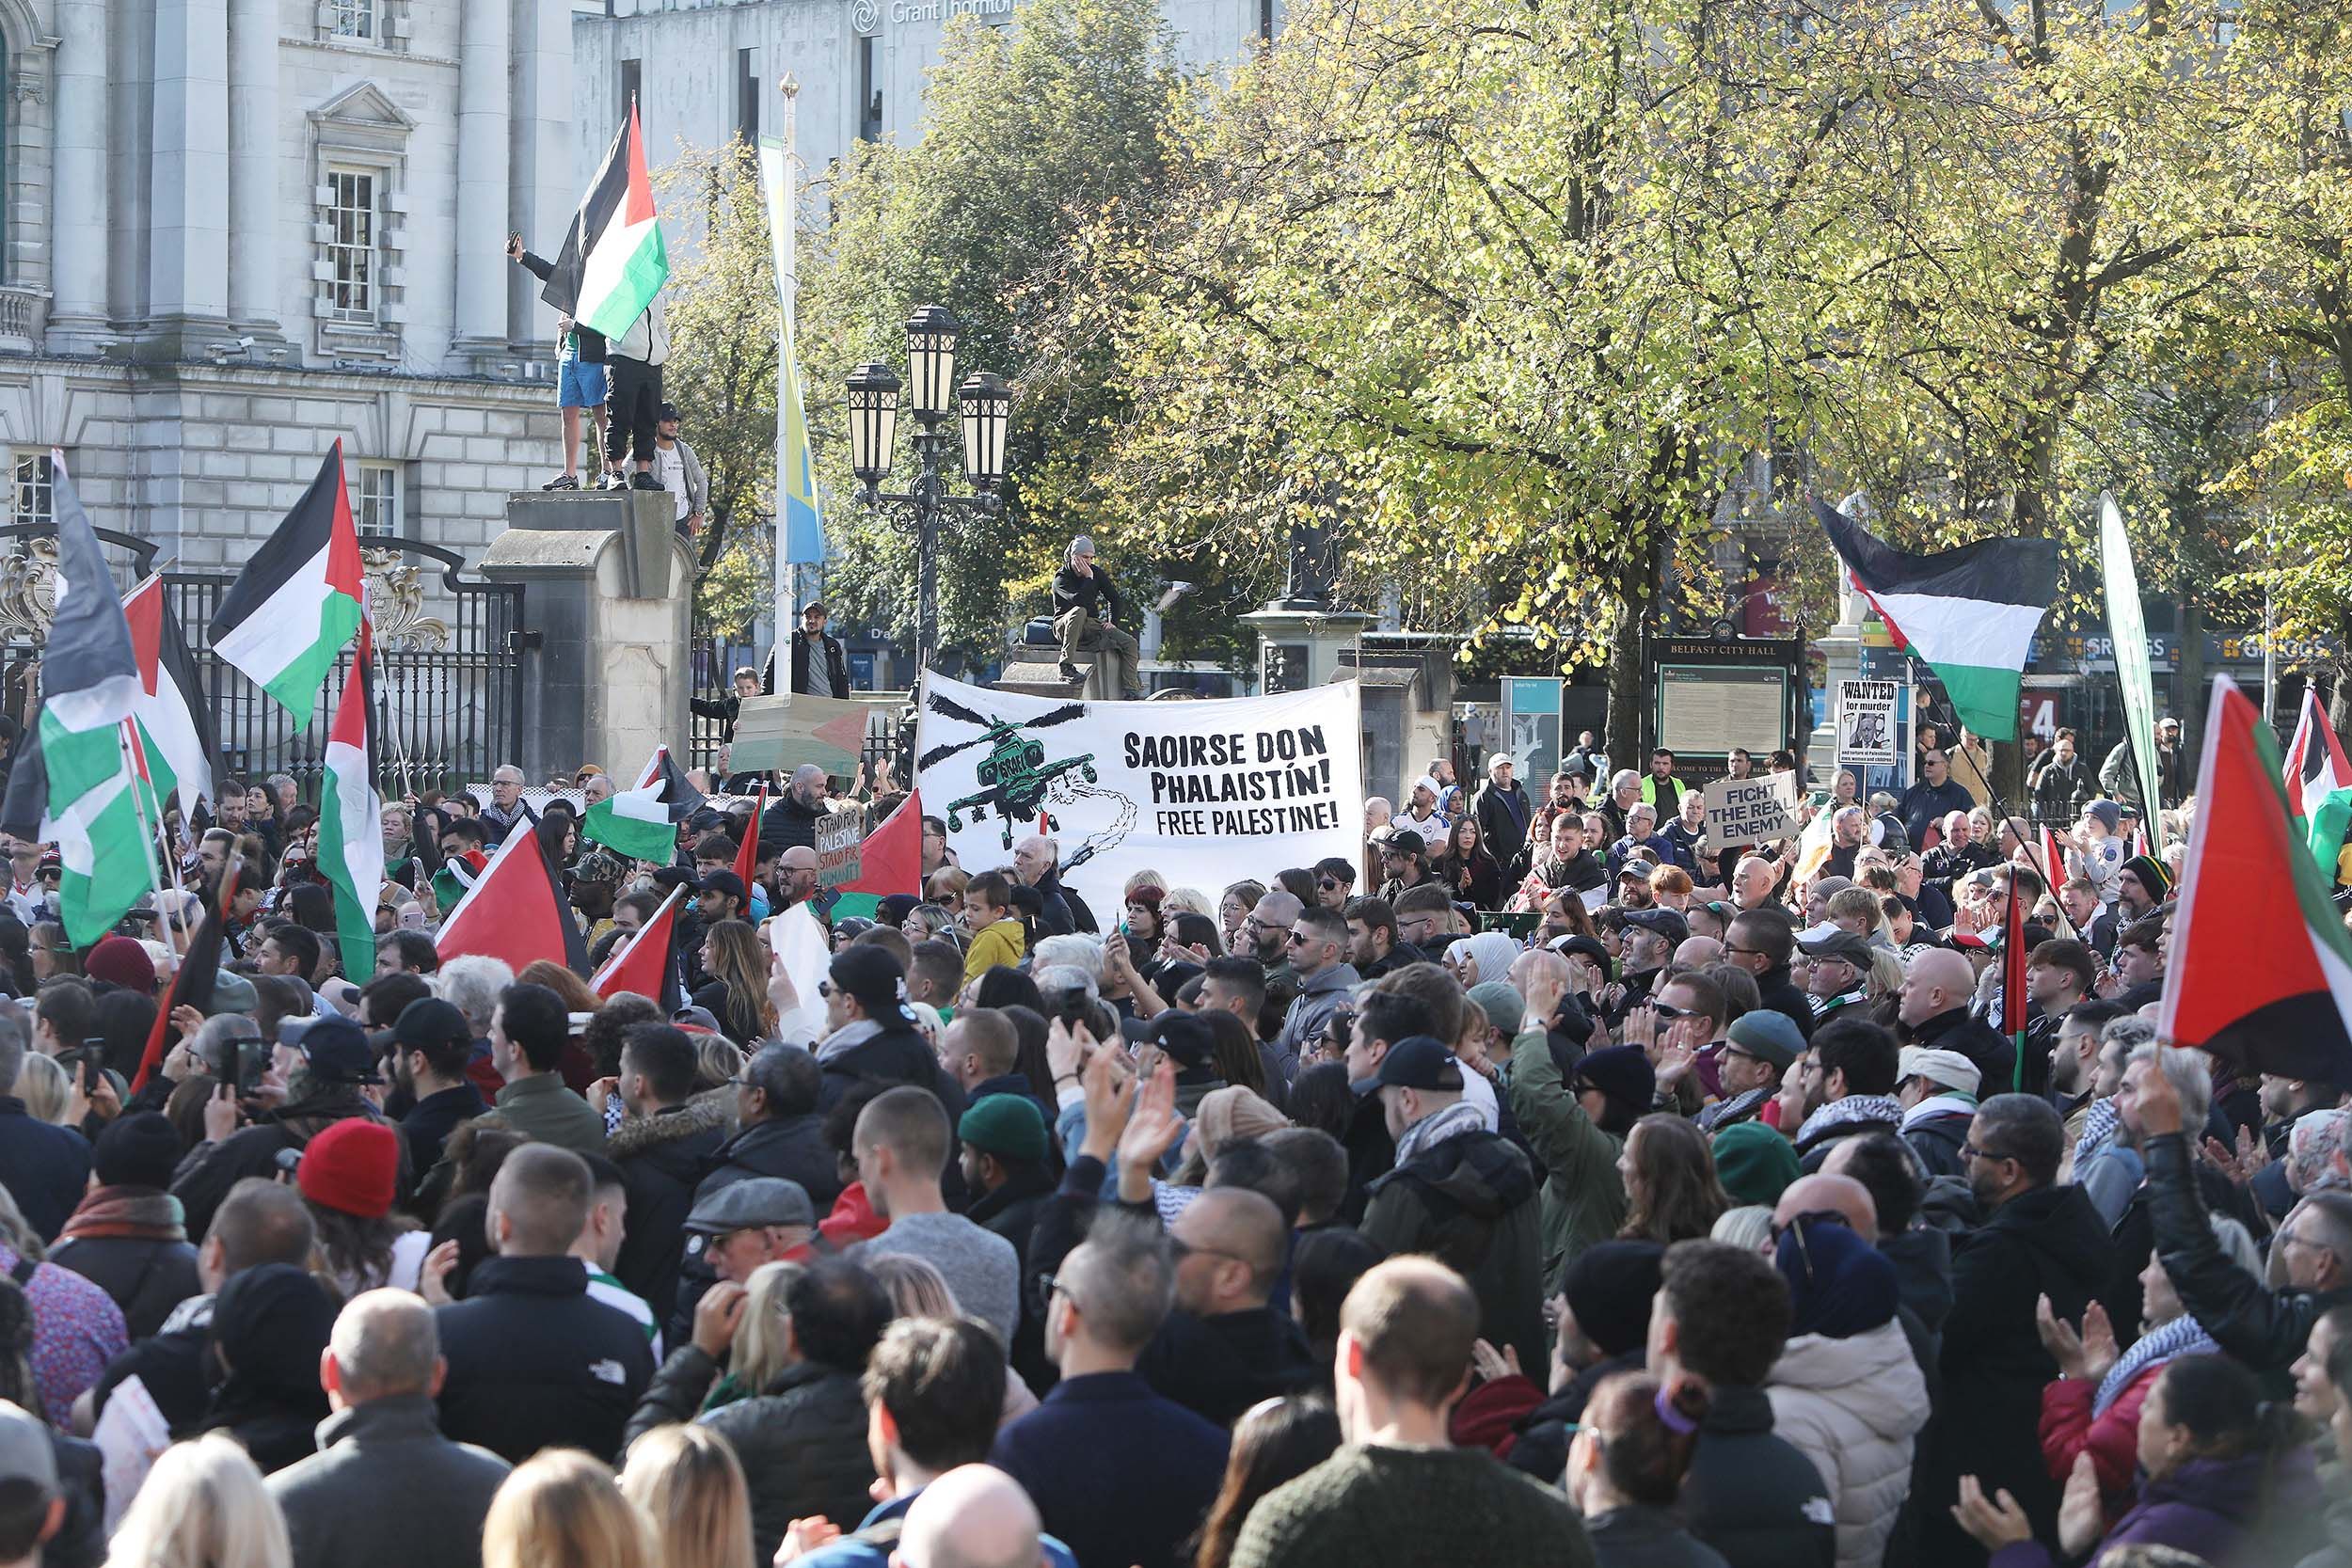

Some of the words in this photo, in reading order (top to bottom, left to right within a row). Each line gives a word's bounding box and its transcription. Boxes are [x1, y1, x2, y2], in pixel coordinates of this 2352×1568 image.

[889, 0, 940, 24] Grant
[1671, 644, 1716, 654] BELFAST
[1719, 645, 1745, 655] CITY
[1748, 646, 1776, 656] HALL
[1843, 681, 1895, 700] WANTED
[1846, 701, 1858, 710] for
[1859, 702, 1891, 711] murder
[1124, 732, 1247, 768] SAOIRSE
[1256, 724, 1327, 763] DON
[1151, 758, 1330, 804] PHALAISTÍN!
[1726, 783, 1776, 804] FIGHT
[818, 816, 843, 834] STAND
[844, 809, 857, 826] FOR
[1156, 810, 1206, 835] FREE
[1212, 800, 1339, 835] PALESTINE!
[1708, 803, 1747, 823] THE
[1750, 798, 1793, 818] REAL
[1723, 815, 1786, 839] ENEMY
[819, 827, 860, 853] PALESTINE
[818, 850, 844, 870] STAND
